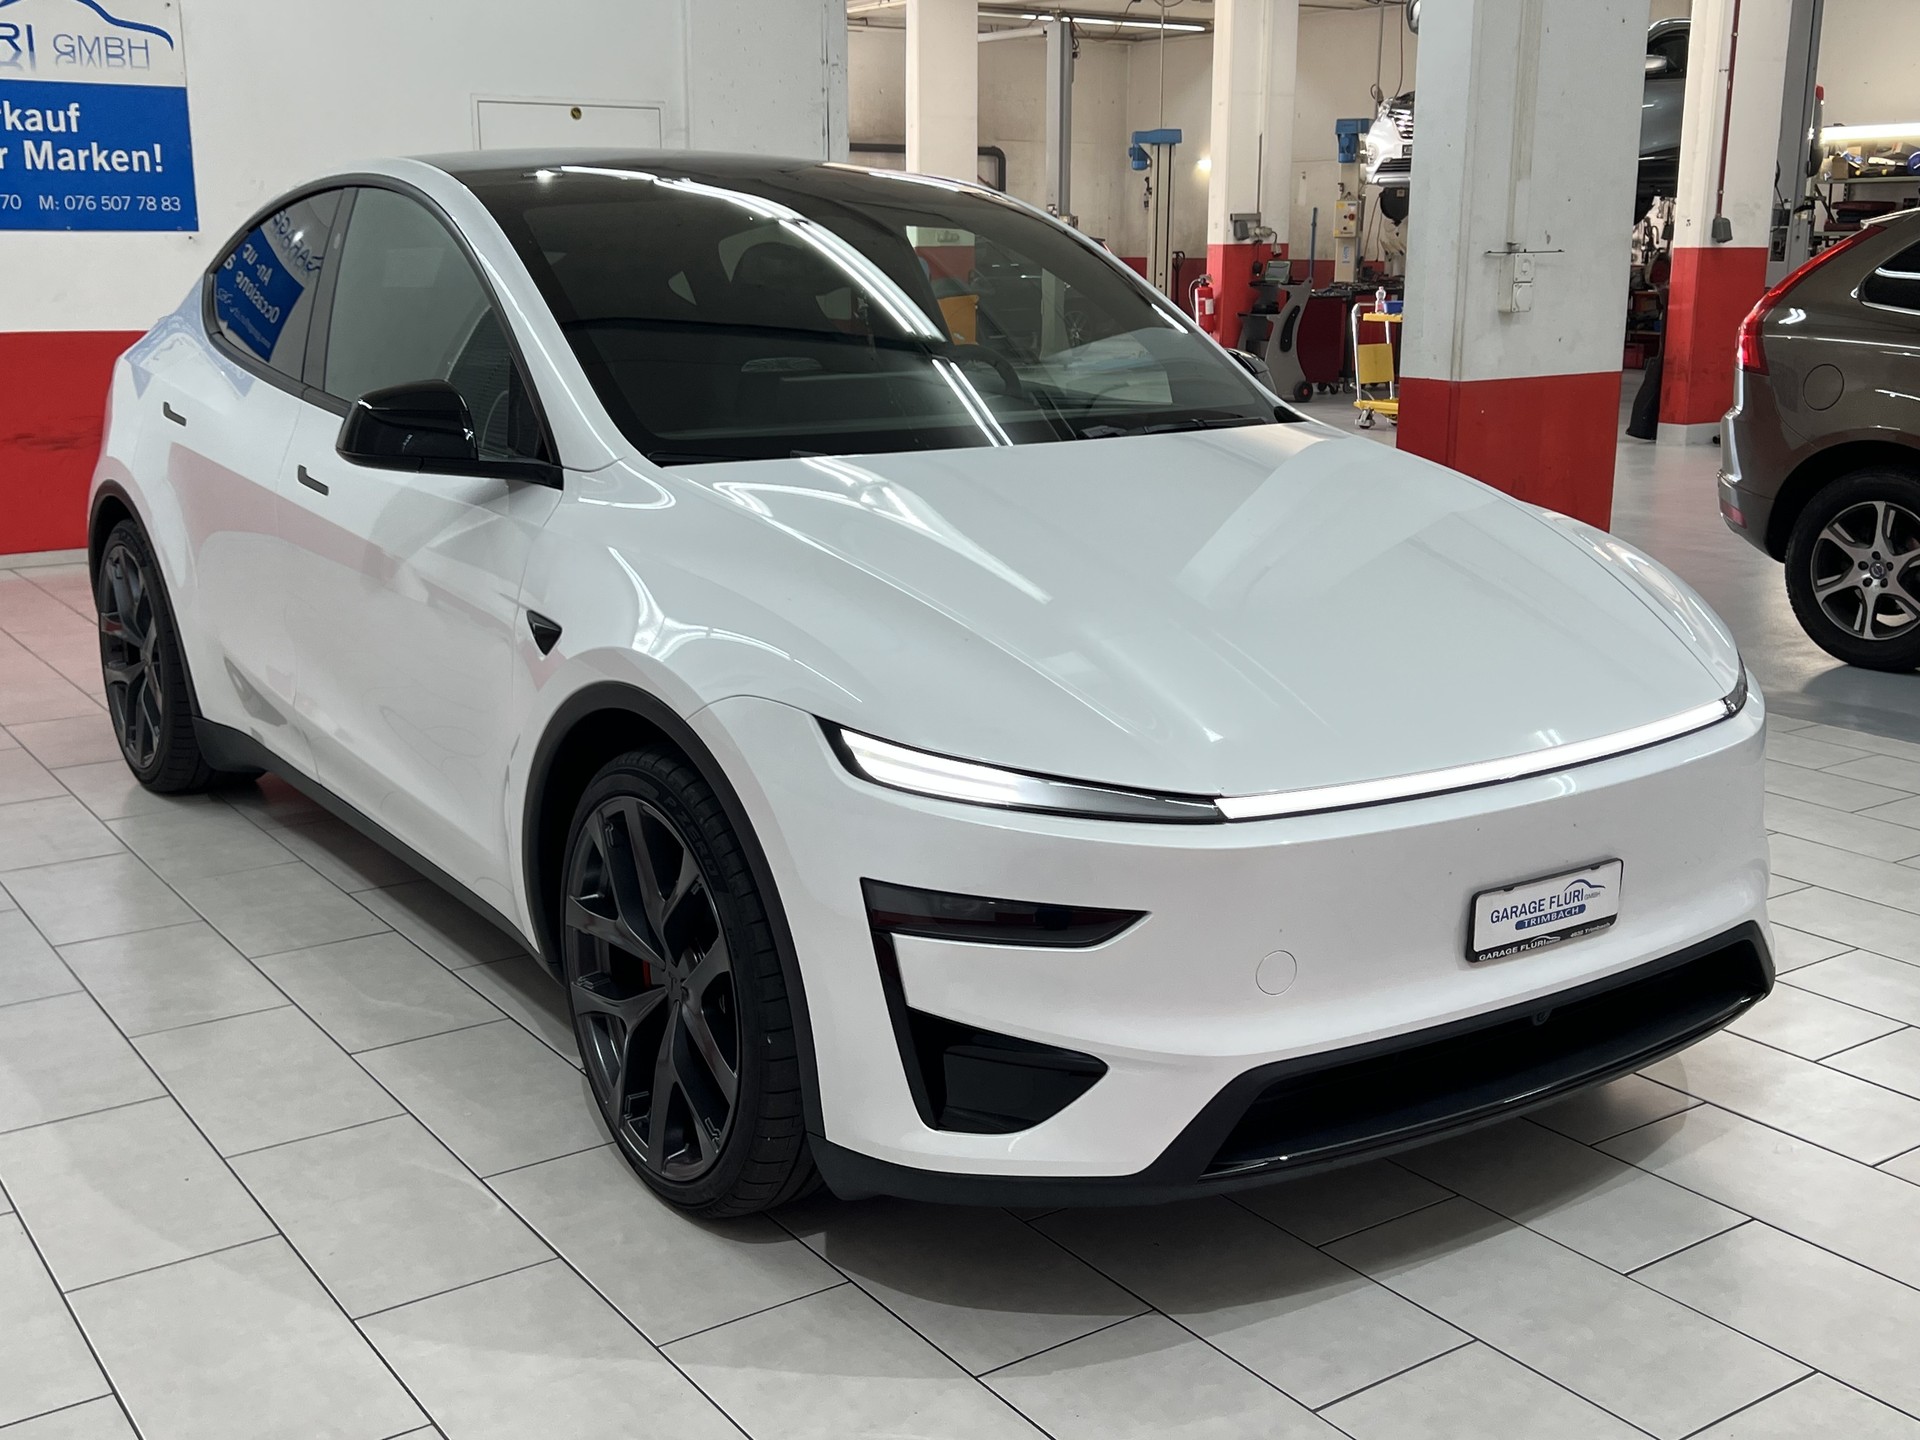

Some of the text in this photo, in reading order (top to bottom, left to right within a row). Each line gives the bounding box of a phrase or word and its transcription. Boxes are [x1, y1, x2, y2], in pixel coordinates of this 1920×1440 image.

[53, 34, 149, 58] GMBH
[0, 100, 81, 133] kauf
[23, 140, 163, 173] Marken!
[38, 195, 60, 210] M:
[64, 195, 97, 211] 076
[101, 196, 131, 211] 507
[137, 196, 157, 211] 78
[161, 196, 181, 212] 83
[1490, 898, 1546, 924] GARAGE
[1523, 906, 1580, 928] TRIMBACH
[1479, 946, 1518, 962] GARAGE
